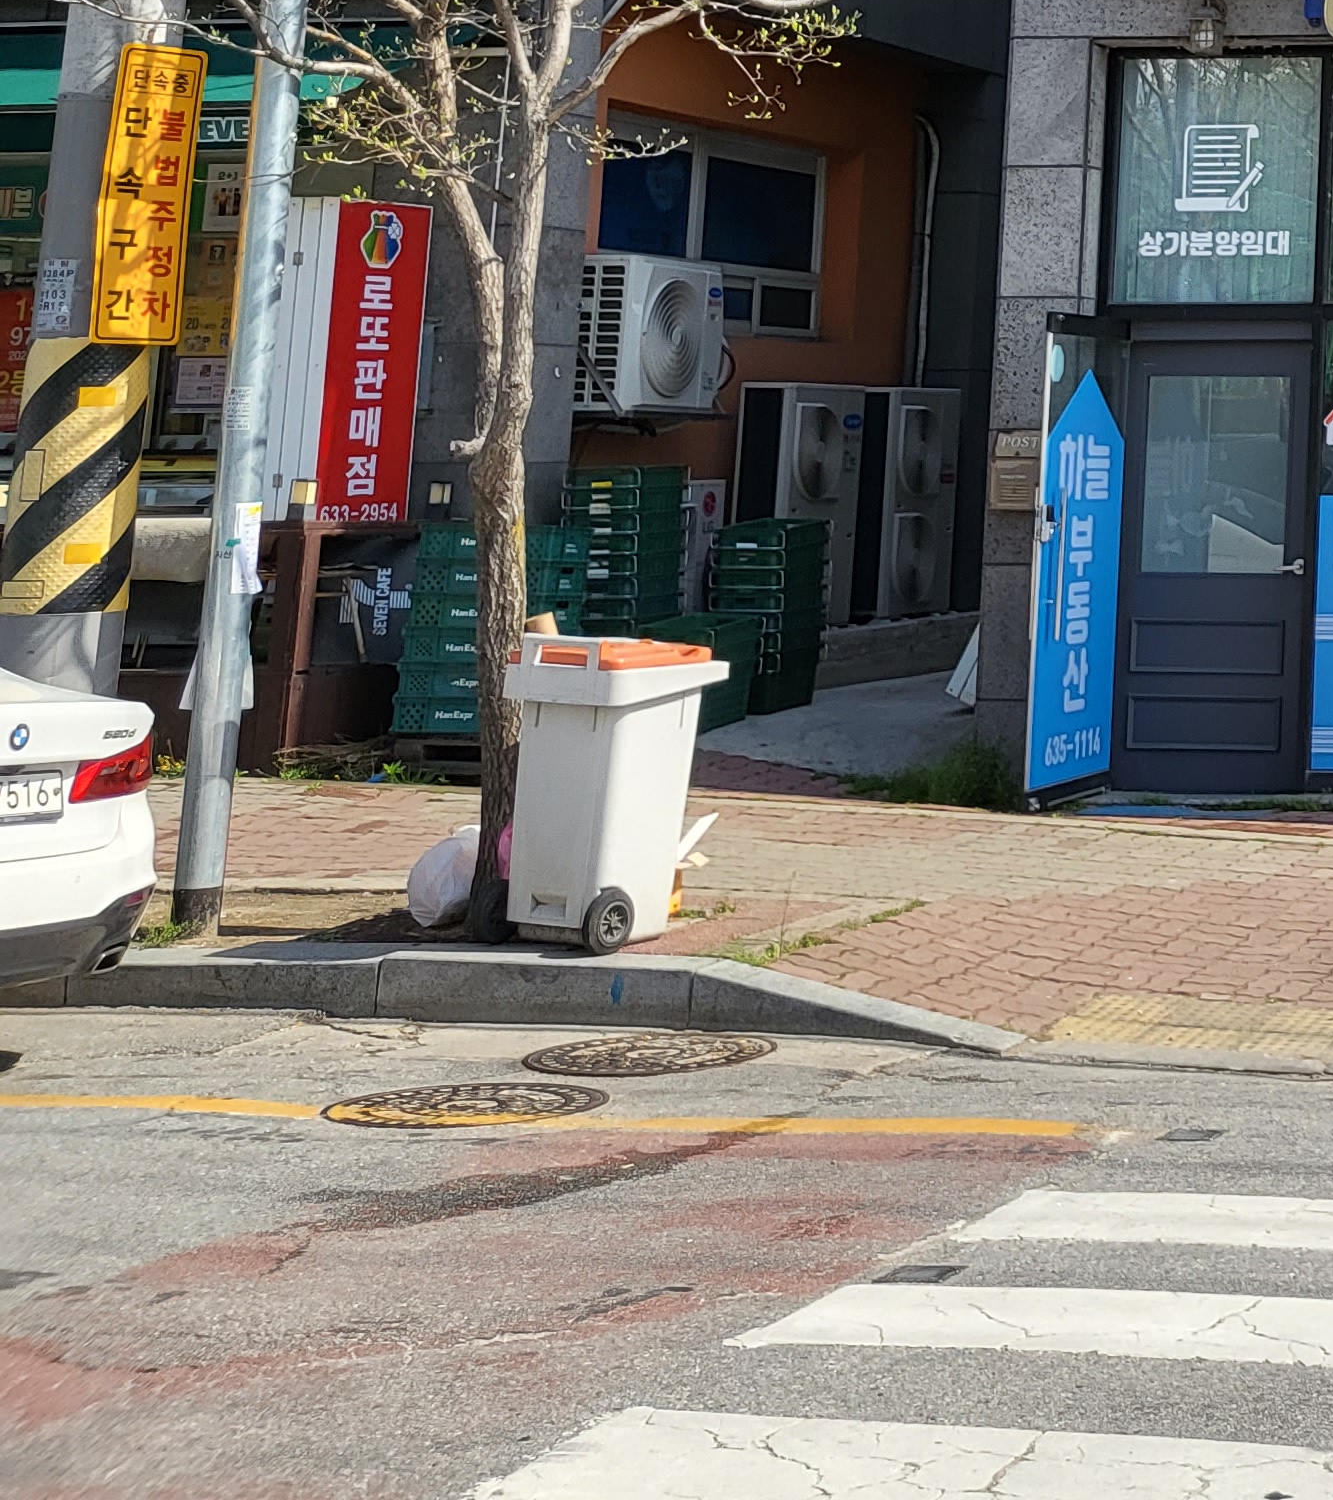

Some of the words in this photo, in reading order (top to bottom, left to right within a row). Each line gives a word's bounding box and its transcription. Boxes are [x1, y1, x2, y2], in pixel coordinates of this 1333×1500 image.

[133, 69, 189, 94] 단속중
[1138, 230, 1290, 258] 상가분양임대
[345, 275, 394, 496] 로또판매점
[1000, 436, 1040, 448] POST
[1059, 433, 1111, 500] 하늘
[319, 502, 398, 522] 633-2954
[376, 567, 392, 597] CAFE
[372, 600, 389, 636] SEVEN
[1062, 514, 1093, 714] 부동산
[1044, 726, 1102, 767] 635-1114
